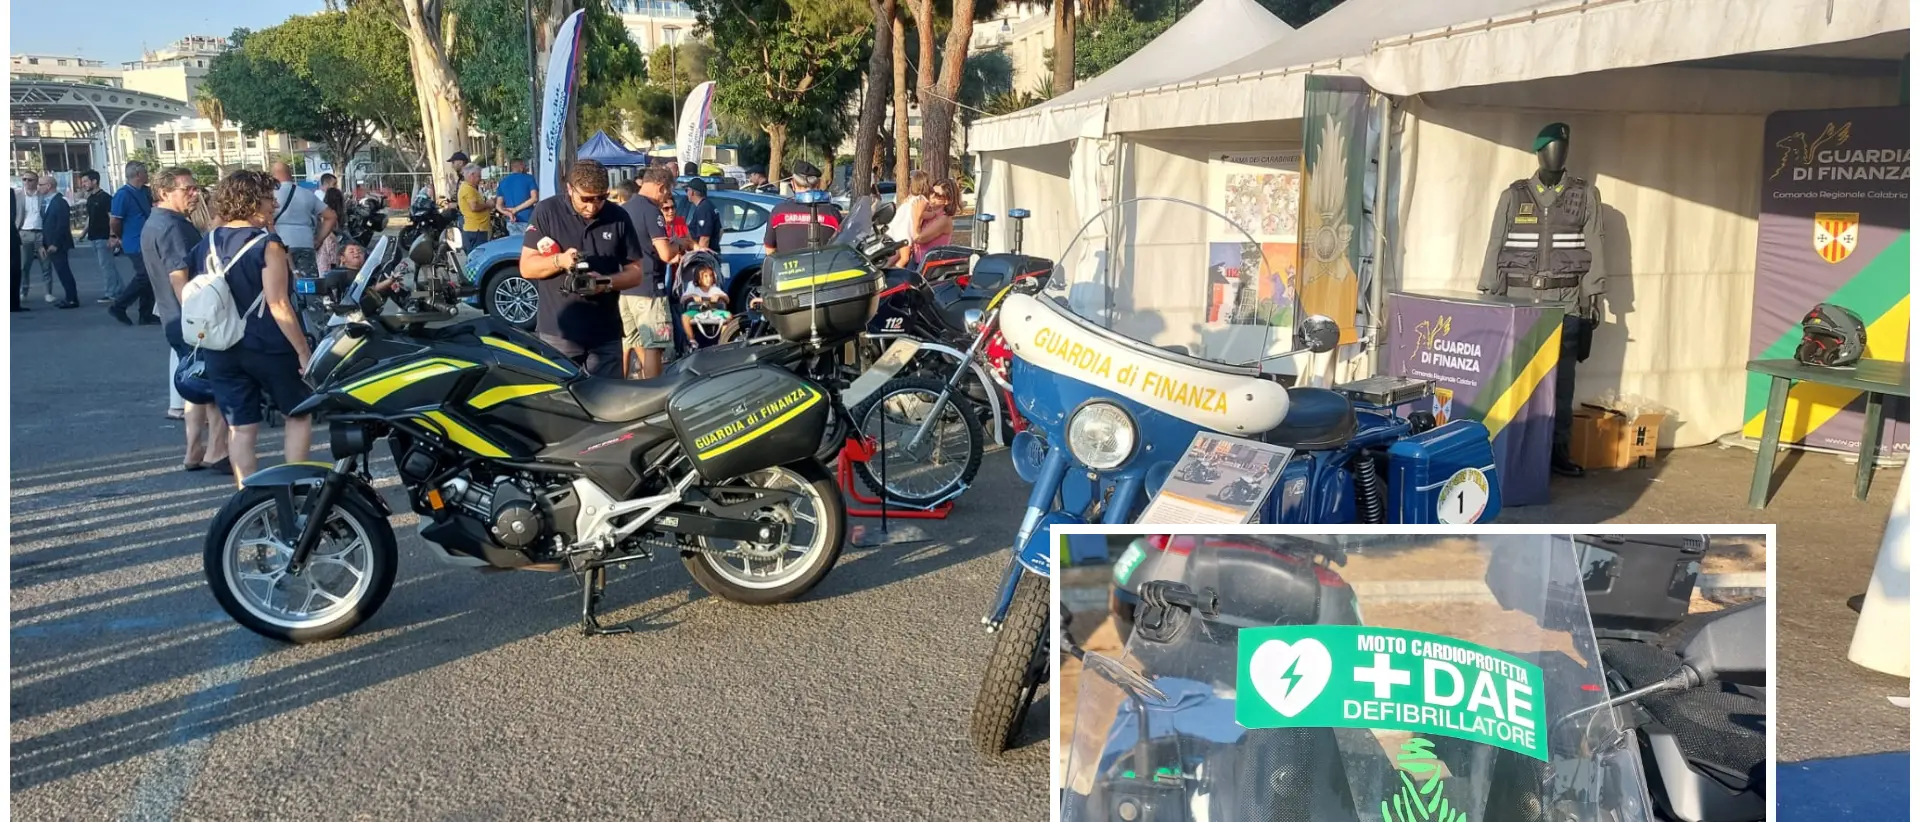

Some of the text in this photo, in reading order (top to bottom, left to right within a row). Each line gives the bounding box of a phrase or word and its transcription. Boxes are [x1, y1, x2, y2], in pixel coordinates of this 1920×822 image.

[1793, 167, 1813, 181] DI
[1773, 190, 1908, 200] Comando Regionale Calabria
[885, 317, 904, 329] 112
[1433, 339, 1482, 358] GUARDIA
[1033, 327, 1228, 415] GUARDIA di FINANZA
[1421, 351, 1480, 373] DI FINANZA
[695, 388, 807, 450] GUARDIA di FINANZA
[1457, 490, 1464, 515] 1
[1357, 635, 1529, 685] MOTO CARDIOPROTETTA
[1343, 699, 1537, 750] DEFIBRILLATORE
